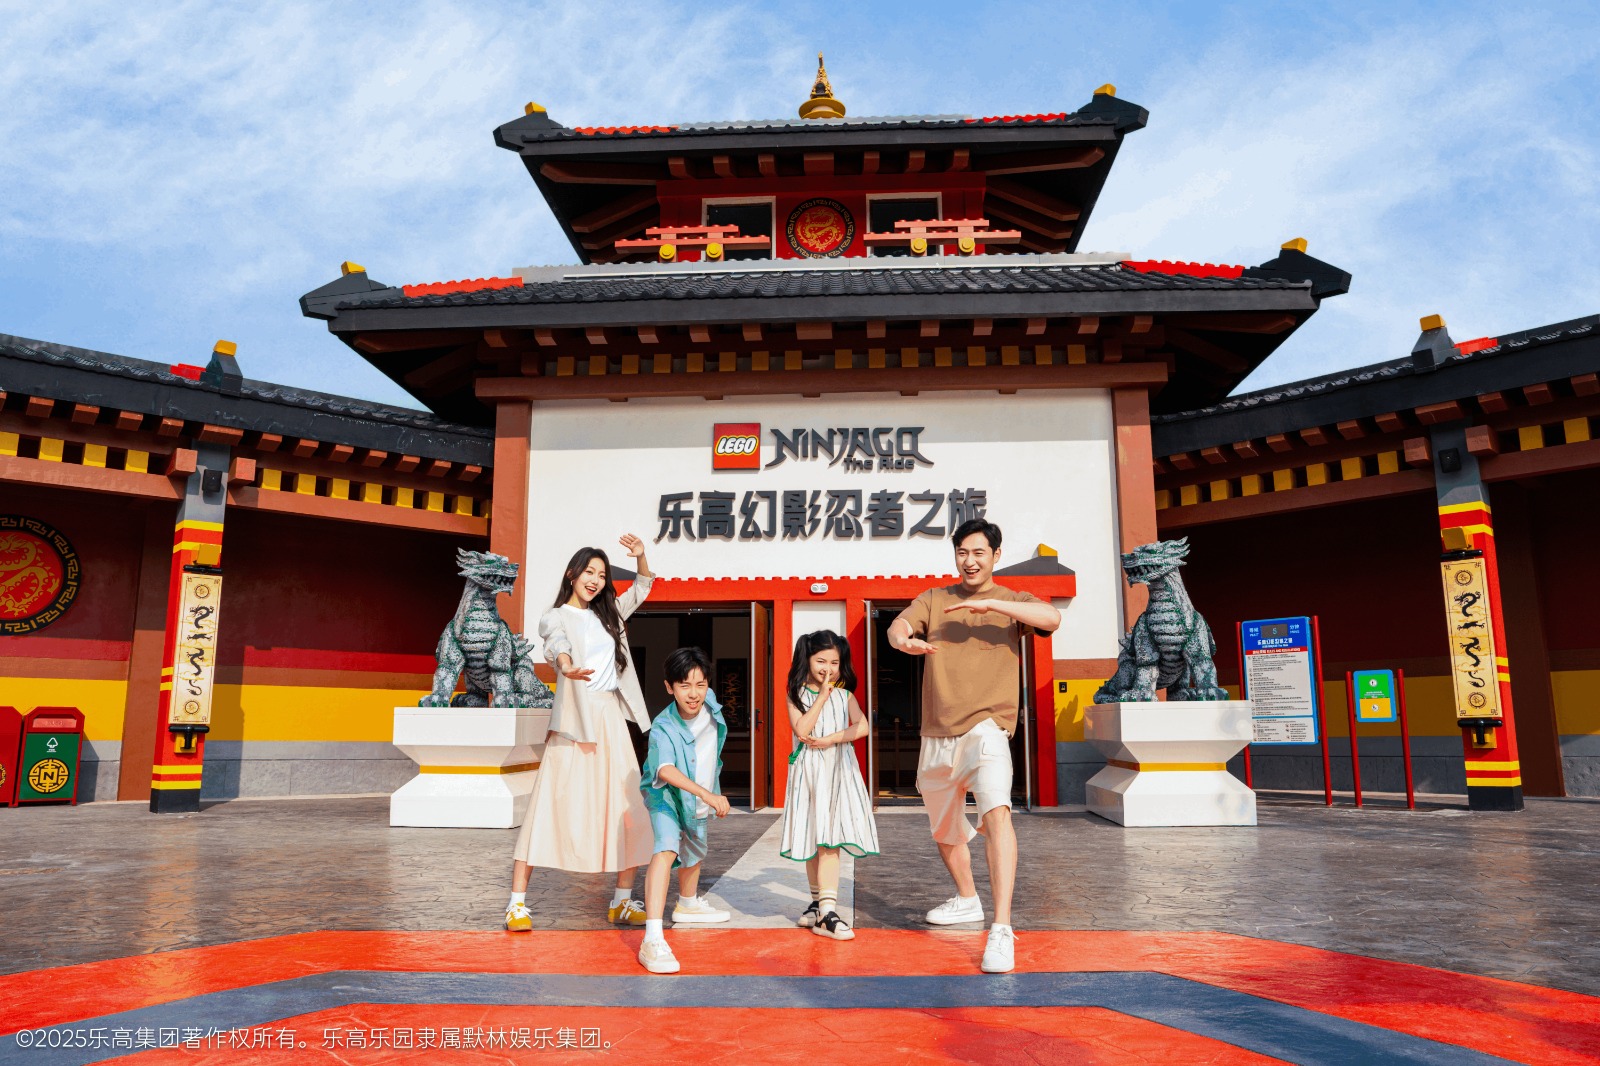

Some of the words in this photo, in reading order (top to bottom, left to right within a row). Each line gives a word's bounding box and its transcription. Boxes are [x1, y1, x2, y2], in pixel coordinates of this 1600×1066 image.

[717, 436, 757, 454] LEGO
[765, 427, 934, 467] NINJAGO
[844, 457, 873, 470] The
[880, 457, 915, 470] Ride
[658, 488, 987, 539] 乐高幻影忍者之旅
[43, 771, 54, 781] N
